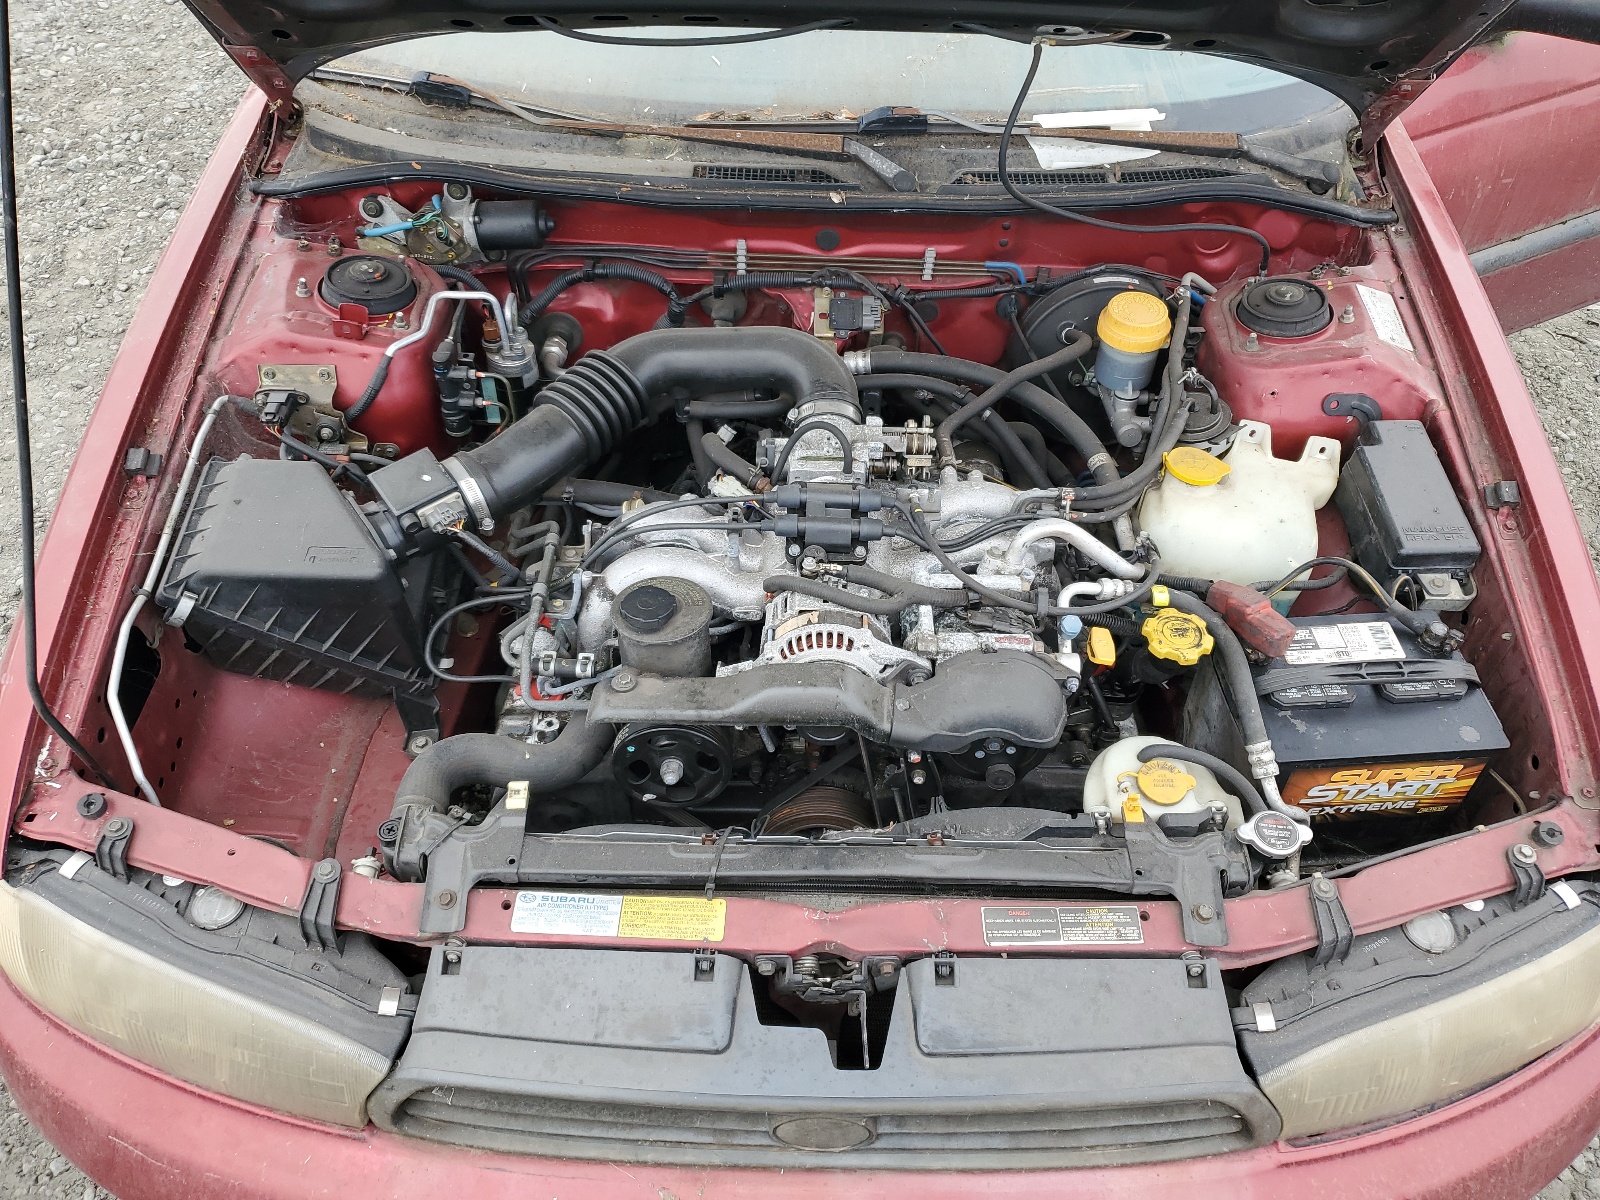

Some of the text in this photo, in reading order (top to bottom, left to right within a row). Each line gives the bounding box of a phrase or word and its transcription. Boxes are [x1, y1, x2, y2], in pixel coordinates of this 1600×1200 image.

[1324, 764, 1464, 786] SUPER
[1299, 777, 1456, 804] START
[1308, 800, 1420, 816] EXTREME
[541, 895, 595, 904] SUBARU
[548, 902, 583, 910] CONDITIONER
